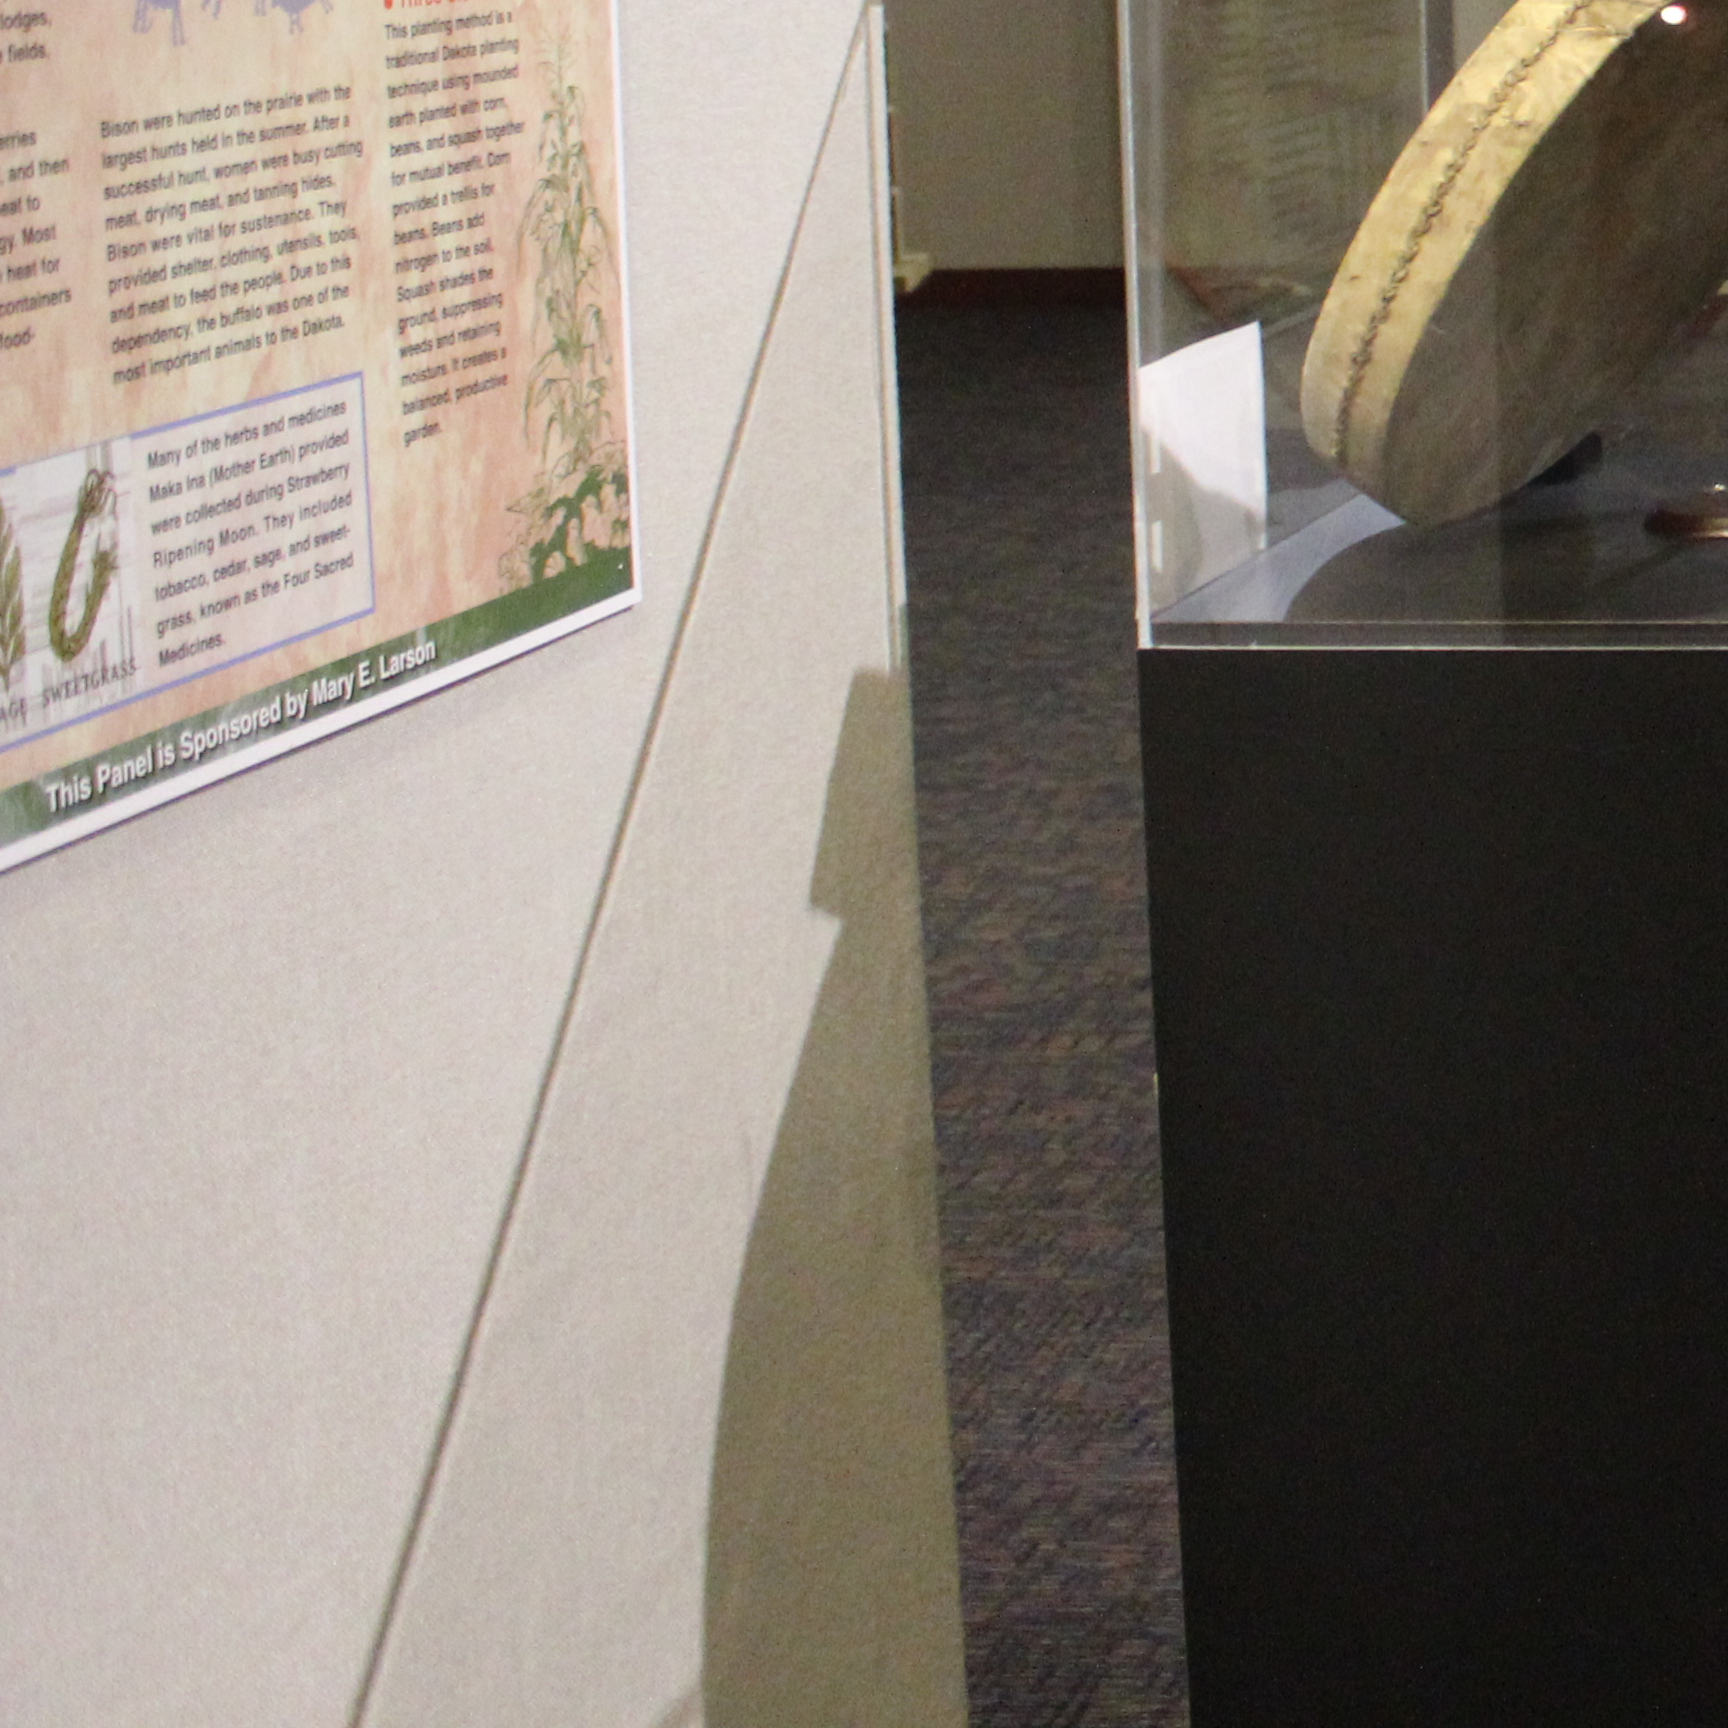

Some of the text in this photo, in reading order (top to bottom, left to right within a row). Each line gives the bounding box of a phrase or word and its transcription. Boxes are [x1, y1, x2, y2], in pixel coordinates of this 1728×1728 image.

[386, 24, 408, 38] This
[411, 18, 453, 38] planting
[454, 12, 493, 30] method
[495, 11, 504, 24] is
[100, 85, 352, 138] Bison were hunted on the prairie with the
[101, 147, 147, 171] largest
[150, 141, 187, 161] hunts
[191, 134, 218, 152] held
[221, 132, 233, 148] in
[236, 129, 256, 145] the
[313, 115, 340, 131] After
[147, 402, 346, 469] Many of the herbs and medicines
[149, 429, 349, 502] Maka Ina (Mother Earth) provided
[151, 466, 349, 535] were collected during Strawberry
[152, 490, 352, 568] Ripening Moon. They included
[289, 534, 311, 557] and
[200, 594, 240, 618] known
[244, 588, 258, 605] as
[261, 580, 280, 598] the
[283, 570, 310, 588] Four
[314, 553, 353, 579] Sacred
[158, 635, 224, 667] Medicines.
[45, 640, 437, 813] This Panel is Sponsored by Mary E. Larson
